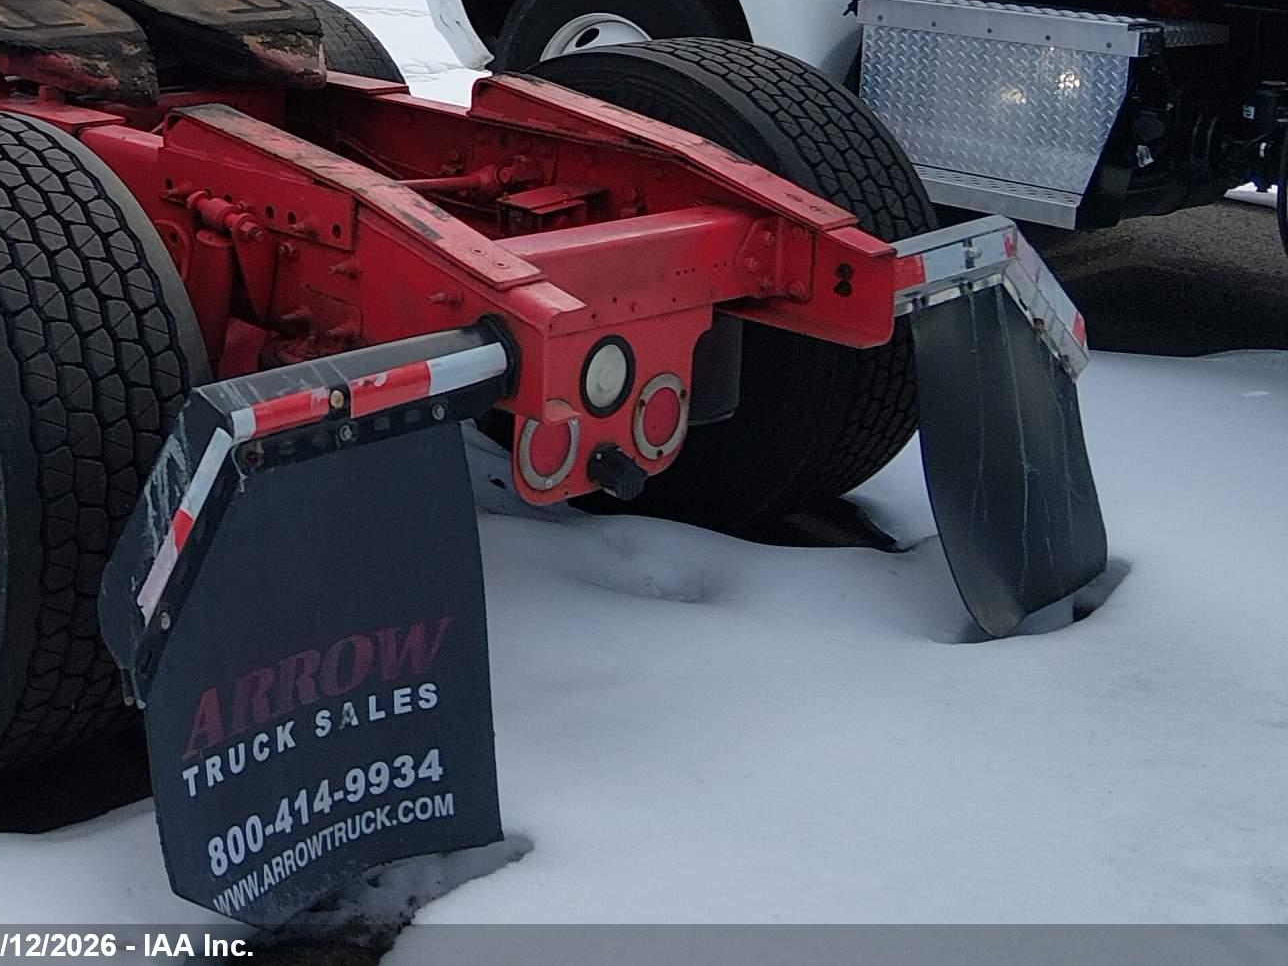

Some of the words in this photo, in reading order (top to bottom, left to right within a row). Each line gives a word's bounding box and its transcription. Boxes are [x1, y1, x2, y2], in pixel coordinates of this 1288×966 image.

[181, 618, 451, 761] ARROW
[182, 721, 297, 797] TRUCK
[315, 683, 438, 738] SALES
[208, 748, 444, 876] 800-414-9934
[212, 793, 455, 917] WWW.ARROWTRUCK.COM
